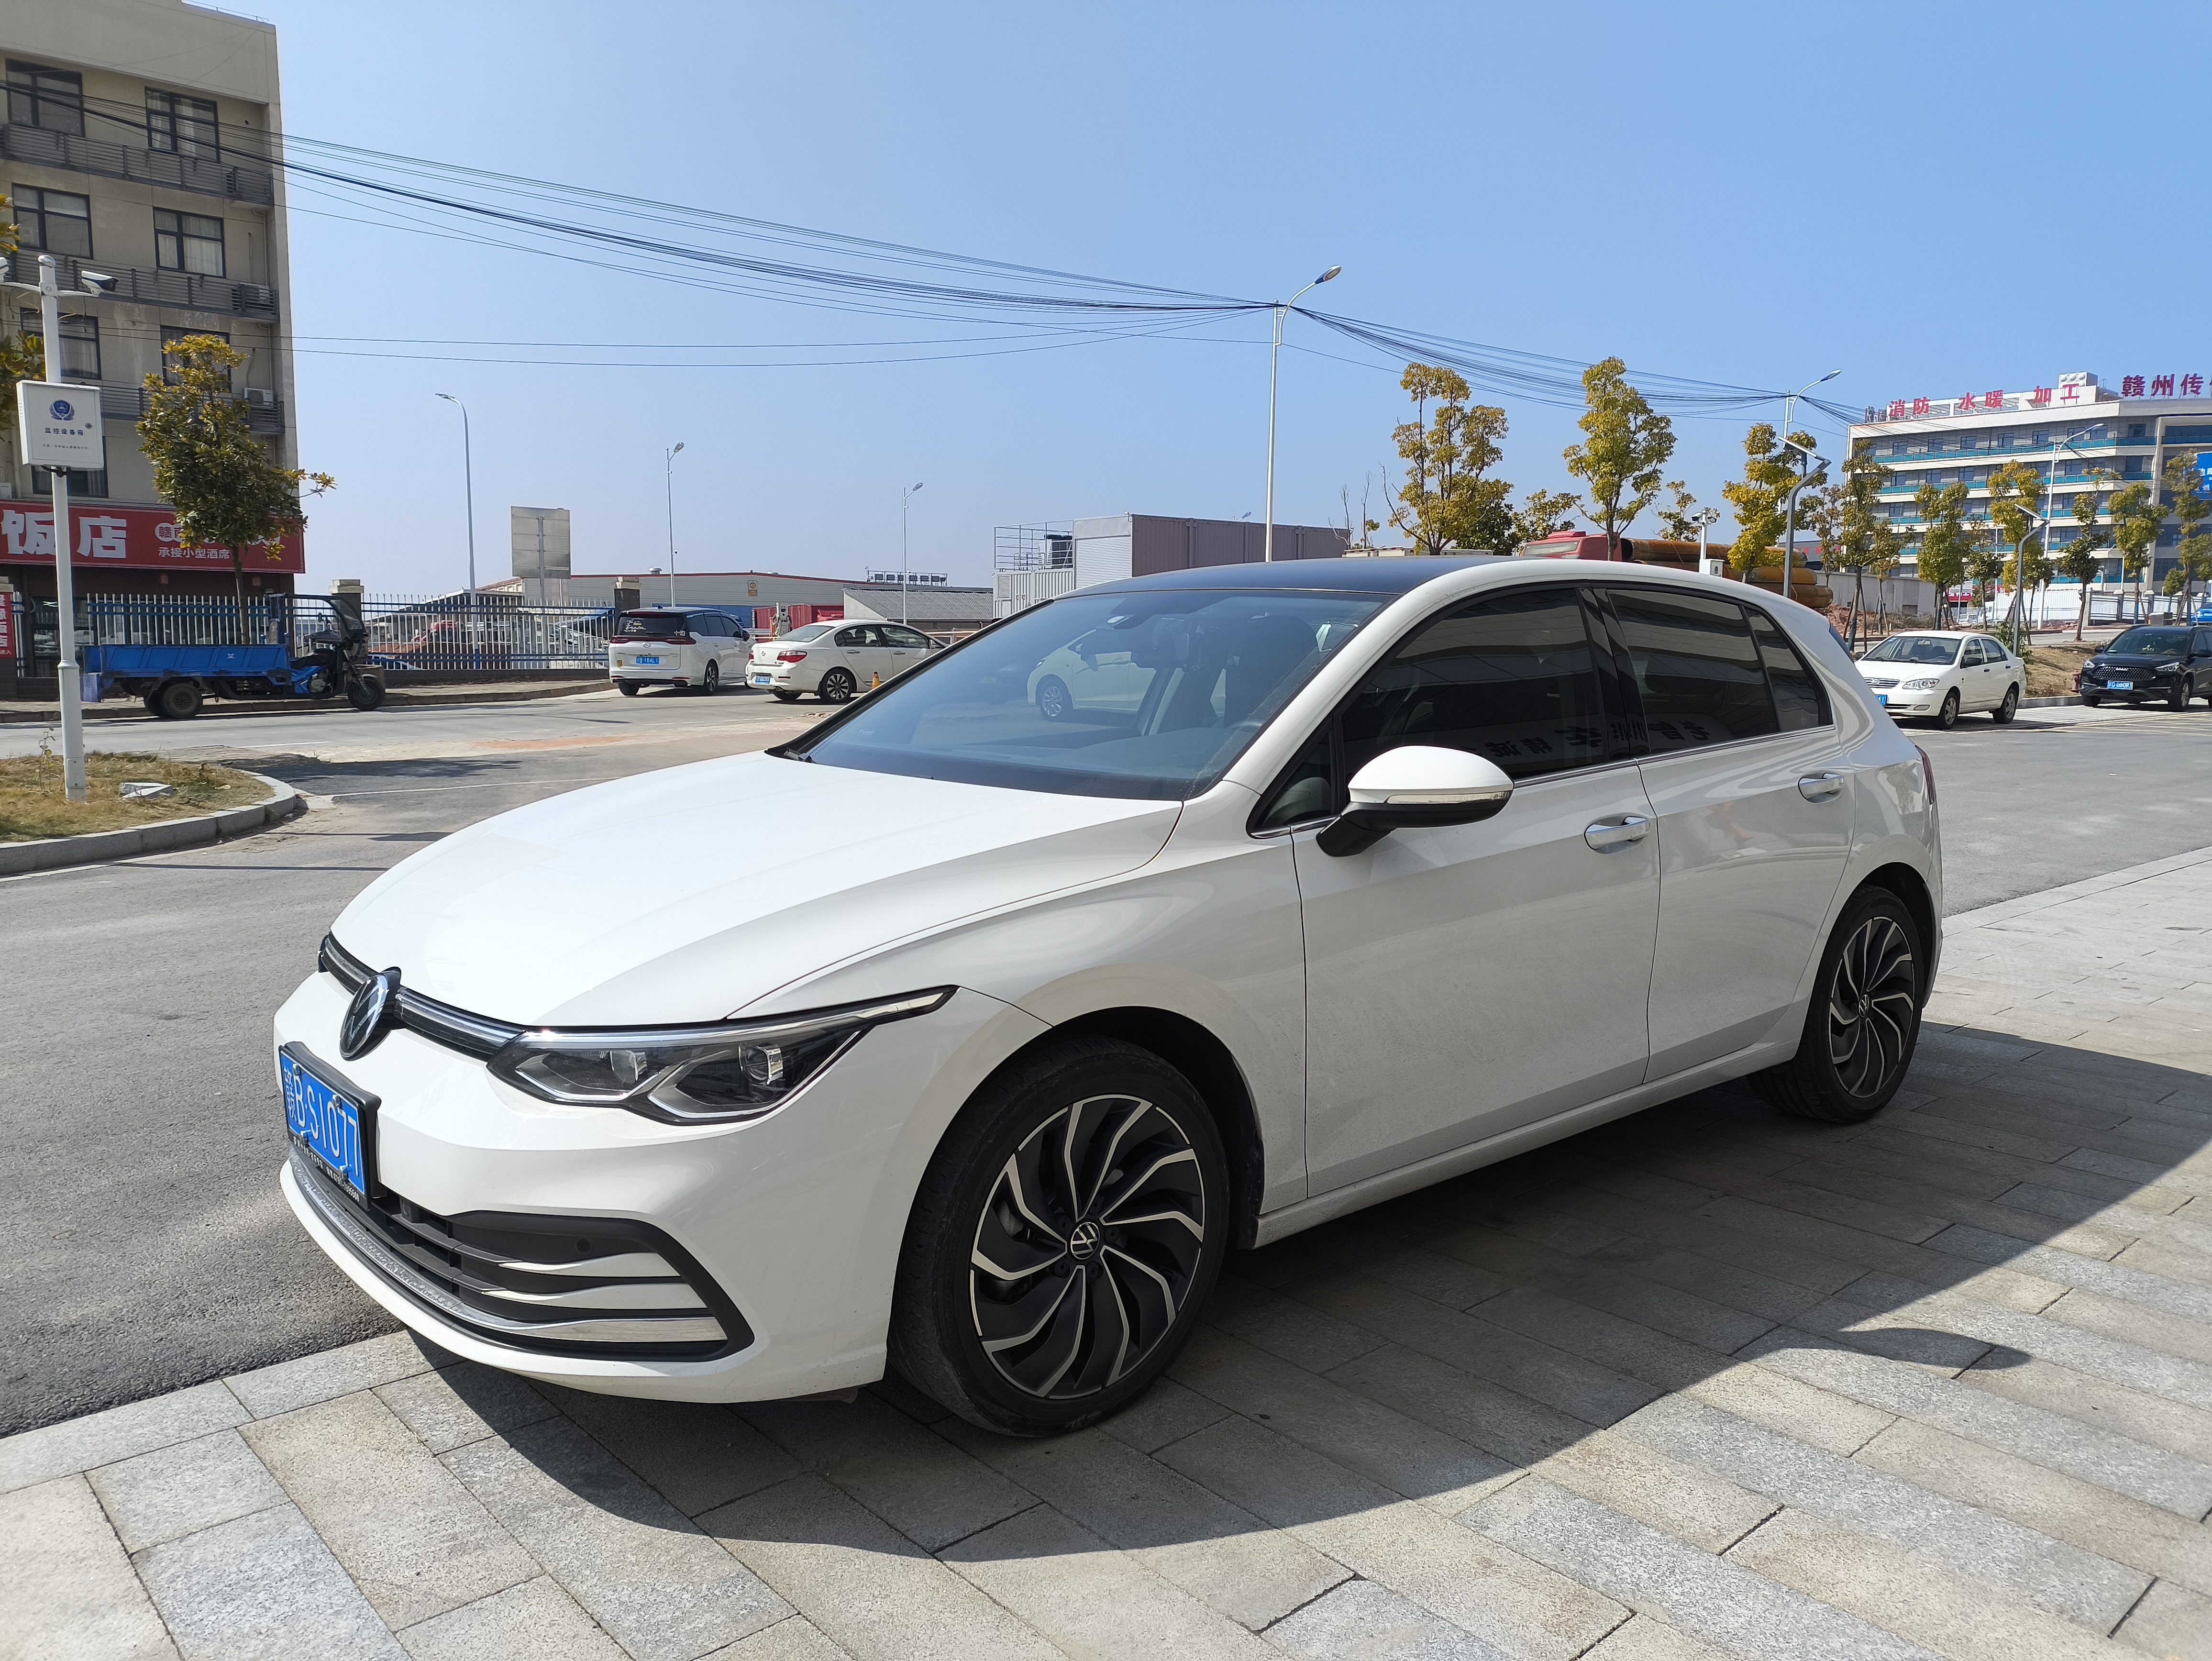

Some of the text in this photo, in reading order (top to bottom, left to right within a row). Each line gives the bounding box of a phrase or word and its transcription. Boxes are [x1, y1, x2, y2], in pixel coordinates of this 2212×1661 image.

[0, 509, 127, 558] 饭店
[158, 547, 230, 560] 承接小型酒席
